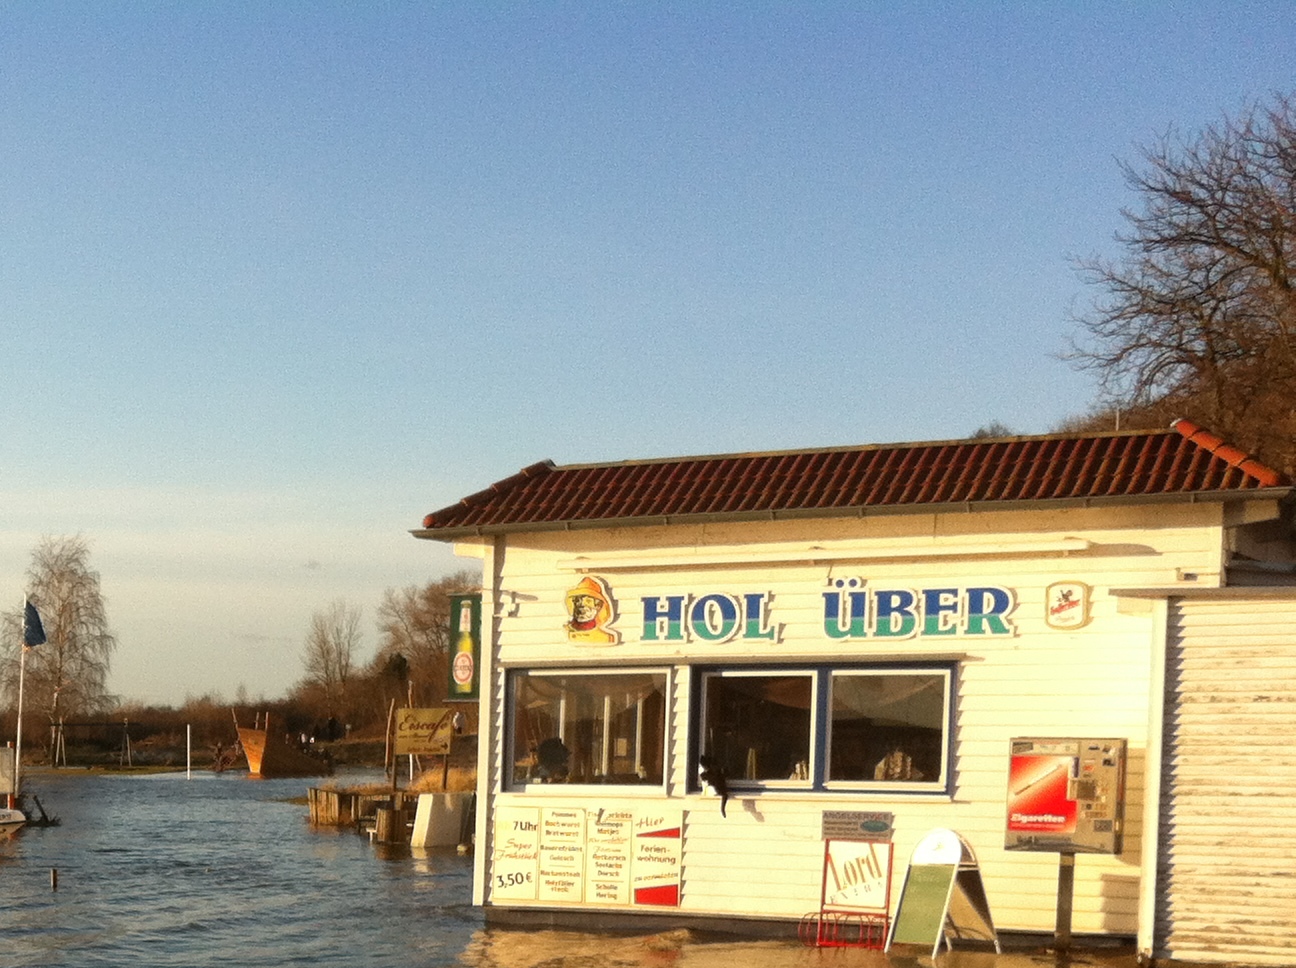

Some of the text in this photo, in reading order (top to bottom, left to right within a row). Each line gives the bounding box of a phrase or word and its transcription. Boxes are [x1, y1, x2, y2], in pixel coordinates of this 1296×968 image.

[641, 578, 1013, 642] HOL ÜBER
[635, 816, 664, 828] Hier
[1010, 813, 1066, 823] Zigaretten
[519, 820, 539, 831] Uhr
[505, 838, 532, 851] Super
[641, 844, 670, 853] Ferien-
[637, 854, 676, 865] wohnung
[826, 842, 882, 891] Lord
